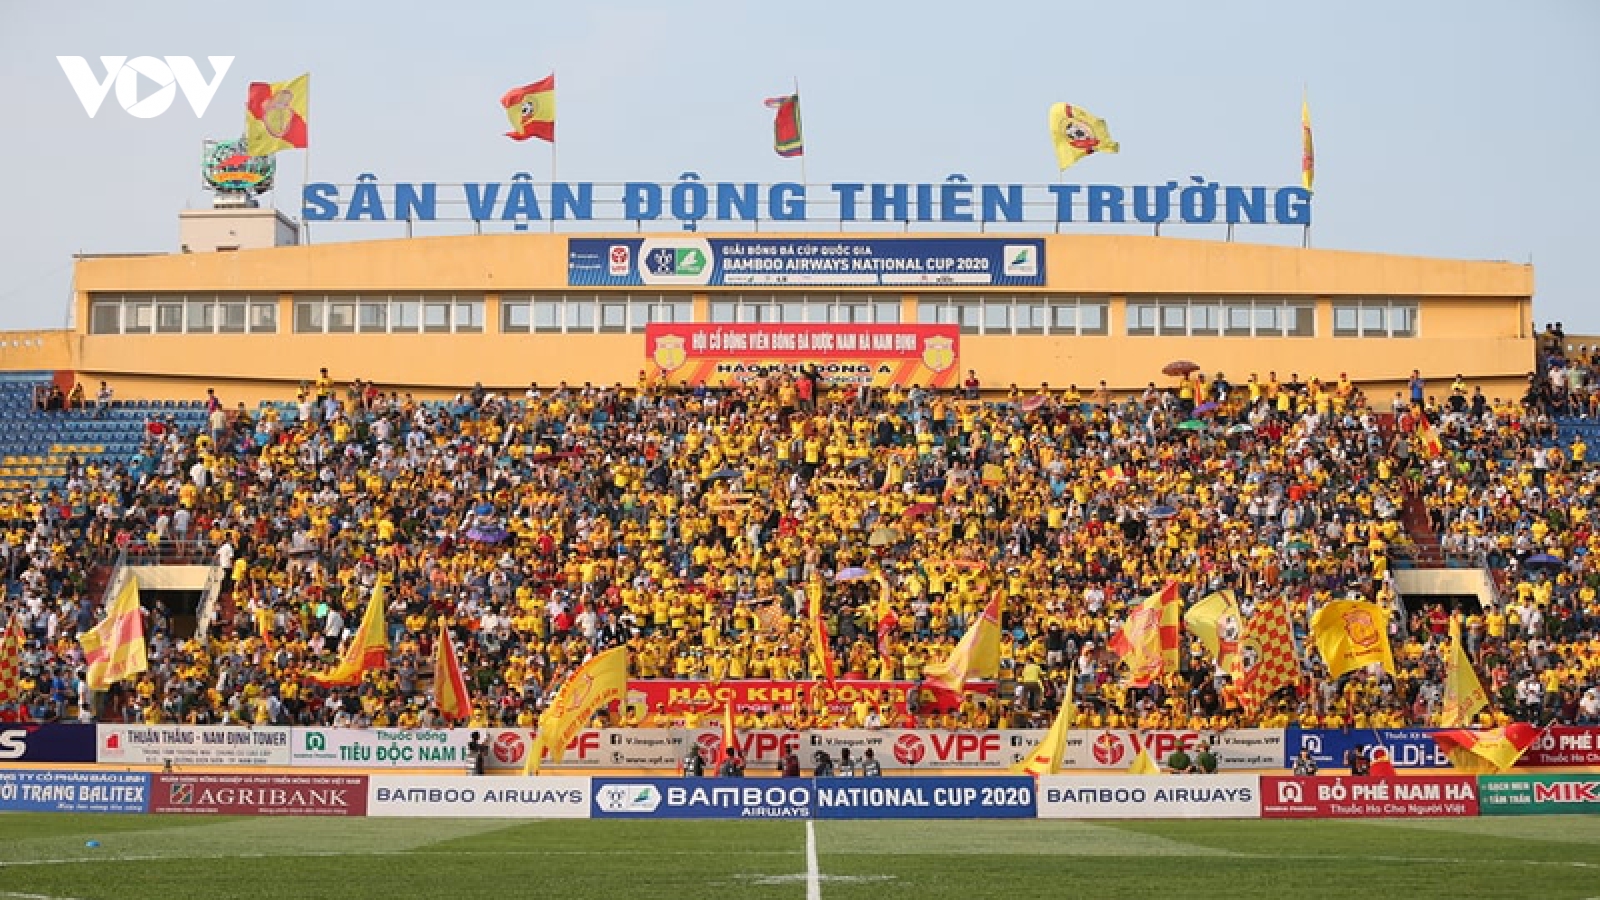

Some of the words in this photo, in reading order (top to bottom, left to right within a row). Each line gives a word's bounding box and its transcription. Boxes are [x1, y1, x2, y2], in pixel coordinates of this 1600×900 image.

[302, 172, 436, 221] SÂN
[464, 172, 592, 231] VẬN
[622, 172, 806, 231] ĐỘNG
[832, 174, 1023, 221] THIÊN
[1049, 176, 1312, 223] TRƯỜNG
[853, 246, 872, 255] GIA
[723, 257, 783, 271] BAMBOO
[786, 257, 849, 271] AIRWAYS
[852, 257, 924, 271] NATIONAL
[926, 257, 955, 271] CUP
[957, 257, 989, 271] 2020
[836, 334, 857, 350] NAM
[873, 334, 893, 350] NAM
[669, 684, 737, 702] HÀO
[202, 732, 224, 744] NAM
[253, 732, 287, 746] TOWER
[339, 742, 371, 761] TIÊU
[376, 743, 413, 765] ĐỘC
[419, 746, 457, 761] NAM
[930, 734, 1001, 761] VPF
[22, 785, 75, 802] TRANG
[80, 785, 143, 802] BALITEX
[198, 789, 349, 806] AGRIBANK
[377, 788, 475, 803] BAMBOO
[484, 788, 583, 803] AIRWAYS
[667, 787, 809, 808] BAMBOO
[818, 787, 928, 806] NATIONAL
[934, 787, 976, 806] CUP
[981, 787, 1031, 806] 2020
[1047, 788, 1146, 803] BAMBOO
[1154, 788, 1253, 803] AIRWAYS
[1394, 784, 1440, 800] NAM
[742, 807, 809, 817] AIRWAYS
[1366, 804, 1381, 813] Ho
[1384, 804, 1405, 813] Cho
